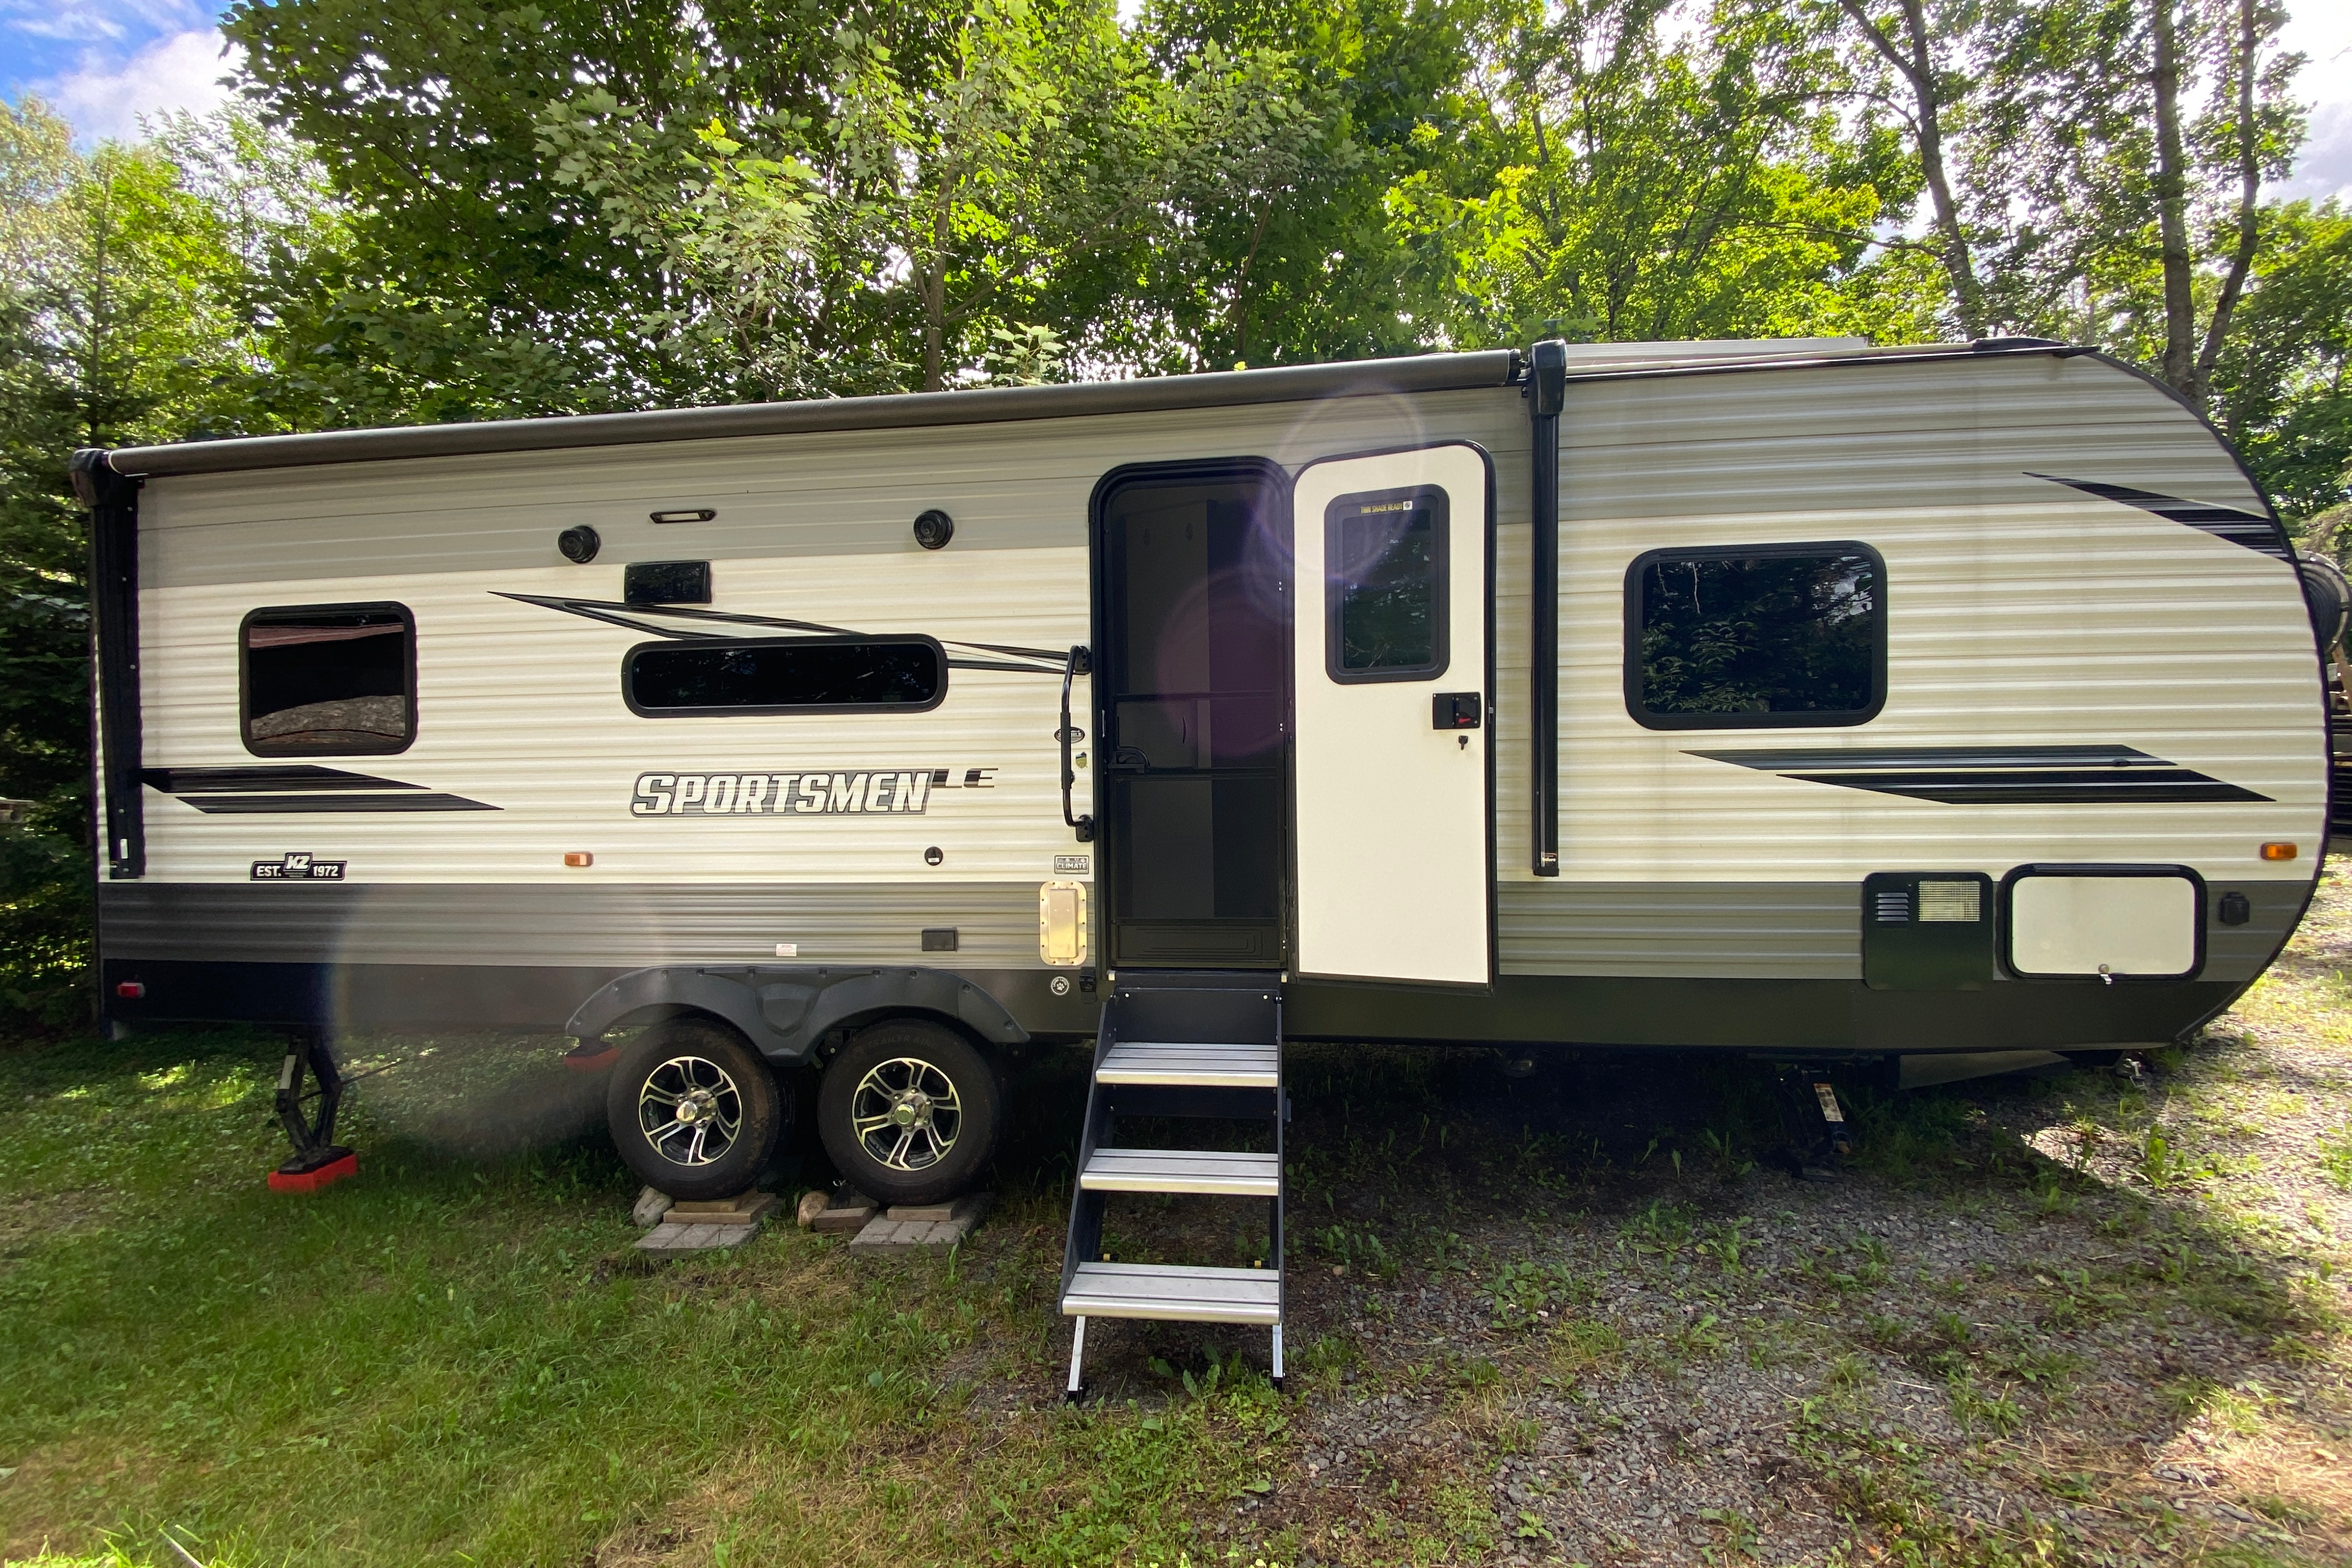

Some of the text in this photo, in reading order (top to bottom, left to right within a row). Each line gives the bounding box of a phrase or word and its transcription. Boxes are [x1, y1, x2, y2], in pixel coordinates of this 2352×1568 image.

[1371, 504, 1387, 513] SHADE
[1388, 503, 1403, 511] READY
[632, 771, 932, 815] SPORTSMEN
[285, 855, 310, 869] KZ
[256, 866, 282, 877] EST.
[313, 865, 339, 877] 1972
